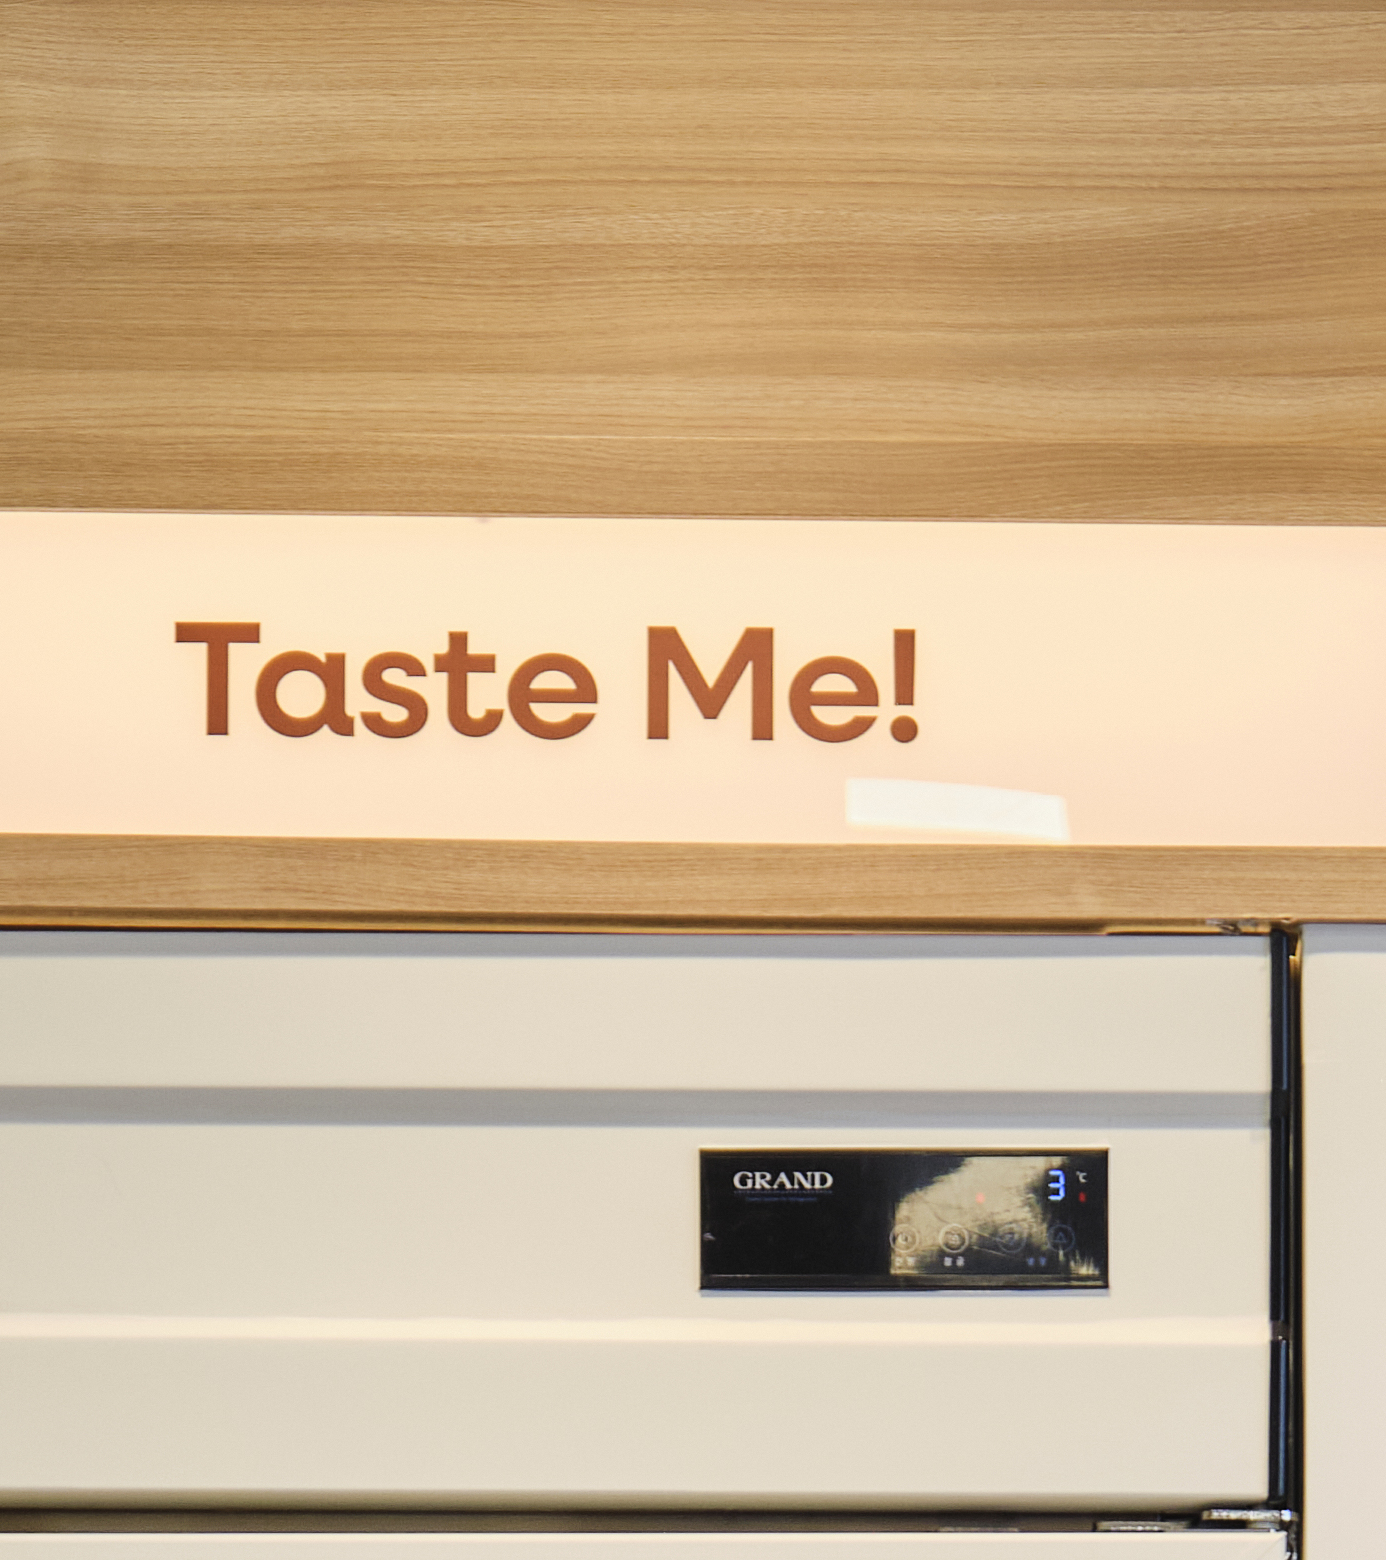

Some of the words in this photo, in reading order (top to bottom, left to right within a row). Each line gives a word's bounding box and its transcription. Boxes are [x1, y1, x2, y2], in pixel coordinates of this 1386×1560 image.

[176, 622, 598, 740] Taste
[645, 627, 920, 744] Me!
[733, 1171, 833, 1190] GRAND
[1048, 1169, 1065, 1200] 3
